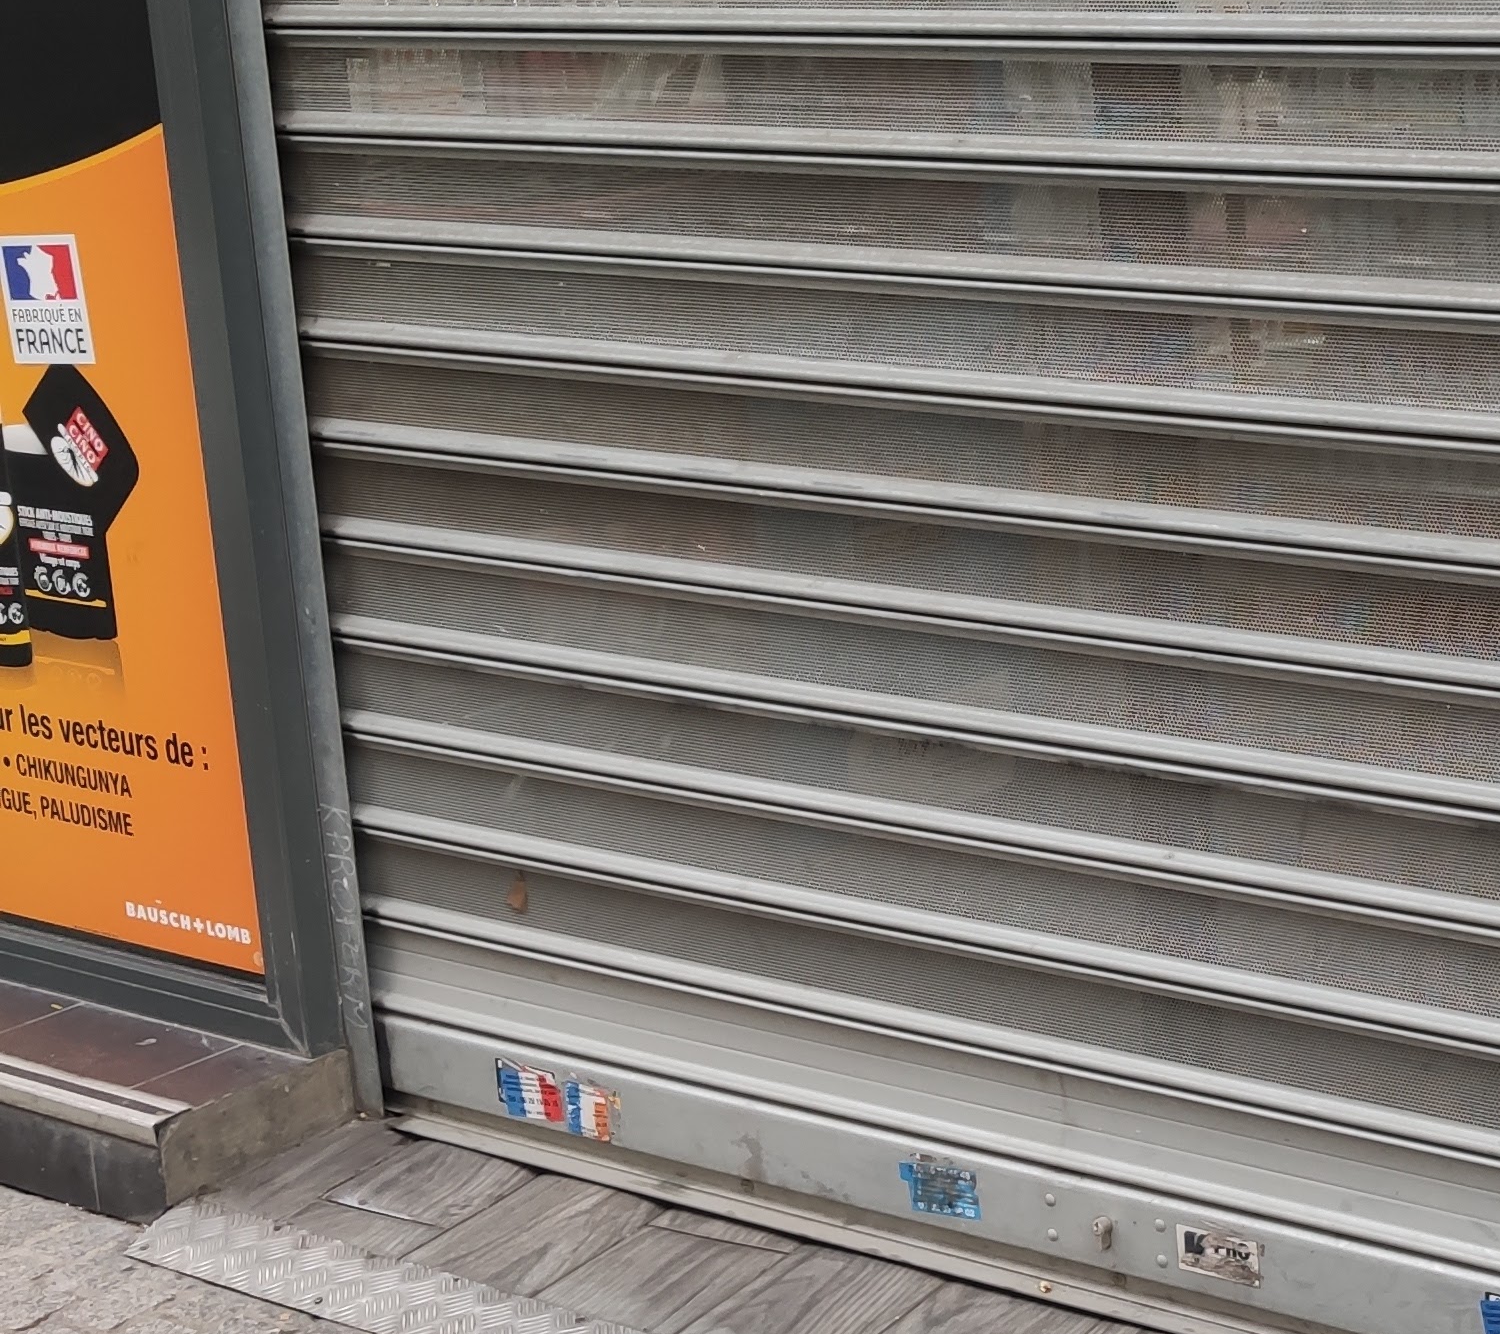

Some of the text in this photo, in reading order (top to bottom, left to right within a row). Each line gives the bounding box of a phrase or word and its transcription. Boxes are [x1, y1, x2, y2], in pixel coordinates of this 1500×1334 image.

[12, 304, 83, 323] FABRIQUÉ EN
[15, 328, 87, 354] FRANCE
[19, 704, 53, 740] les
[59, 719, 158, 761] vecteurs
[165, 733, 194, 768] de
[16, 753, 133, 798] CHIKUNGUNYA
[0, 787, 134, 837] GUE, PALUDISME
